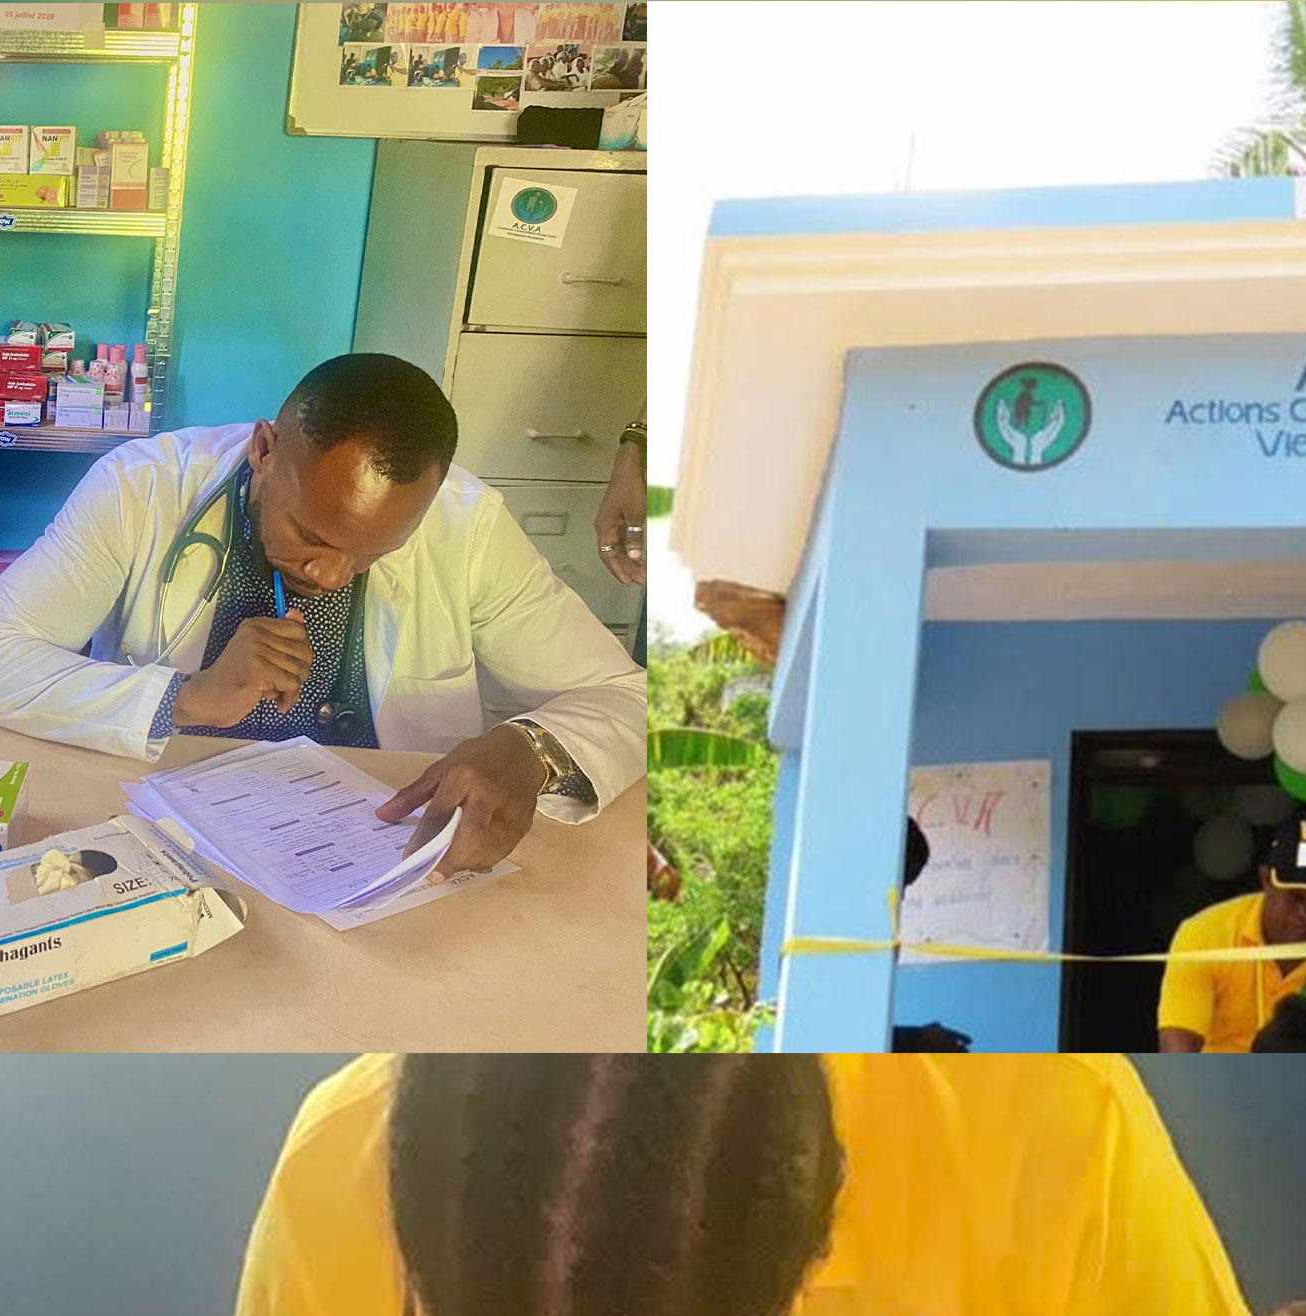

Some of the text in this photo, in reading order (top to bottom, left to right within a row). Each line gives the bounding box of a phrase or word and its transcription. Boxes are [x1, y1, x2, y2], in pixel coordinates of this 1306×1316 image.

[513, 222, 540, 232] A.C.V.A
[1165, 398, 1280, 424] Actions
[113, 876, 152, 895] SIZE:
[40, 978, 75, 994] GLOVES
[42, 971, 70, 985] LATEX
